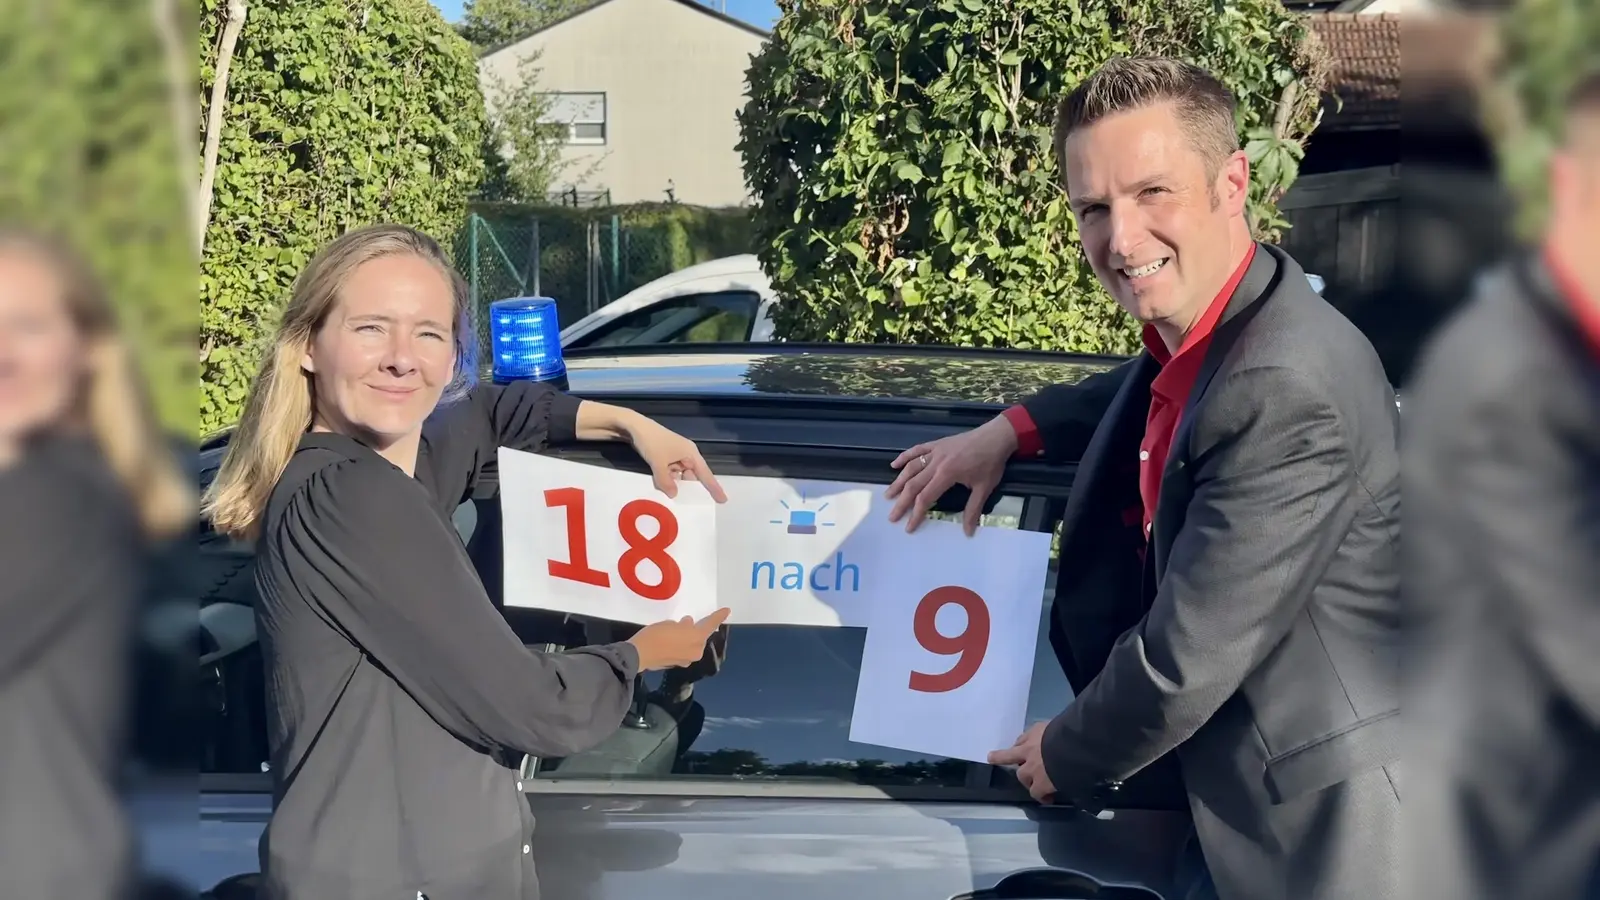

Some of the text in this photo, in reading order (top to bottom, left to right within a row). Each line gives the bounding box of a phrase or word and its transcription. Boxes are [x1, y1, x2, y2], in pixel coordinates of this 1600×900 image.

[543, 486, 682, 601] 18
[750, 552, 860, 592] nach
[908, 585, 991, 693] 9
